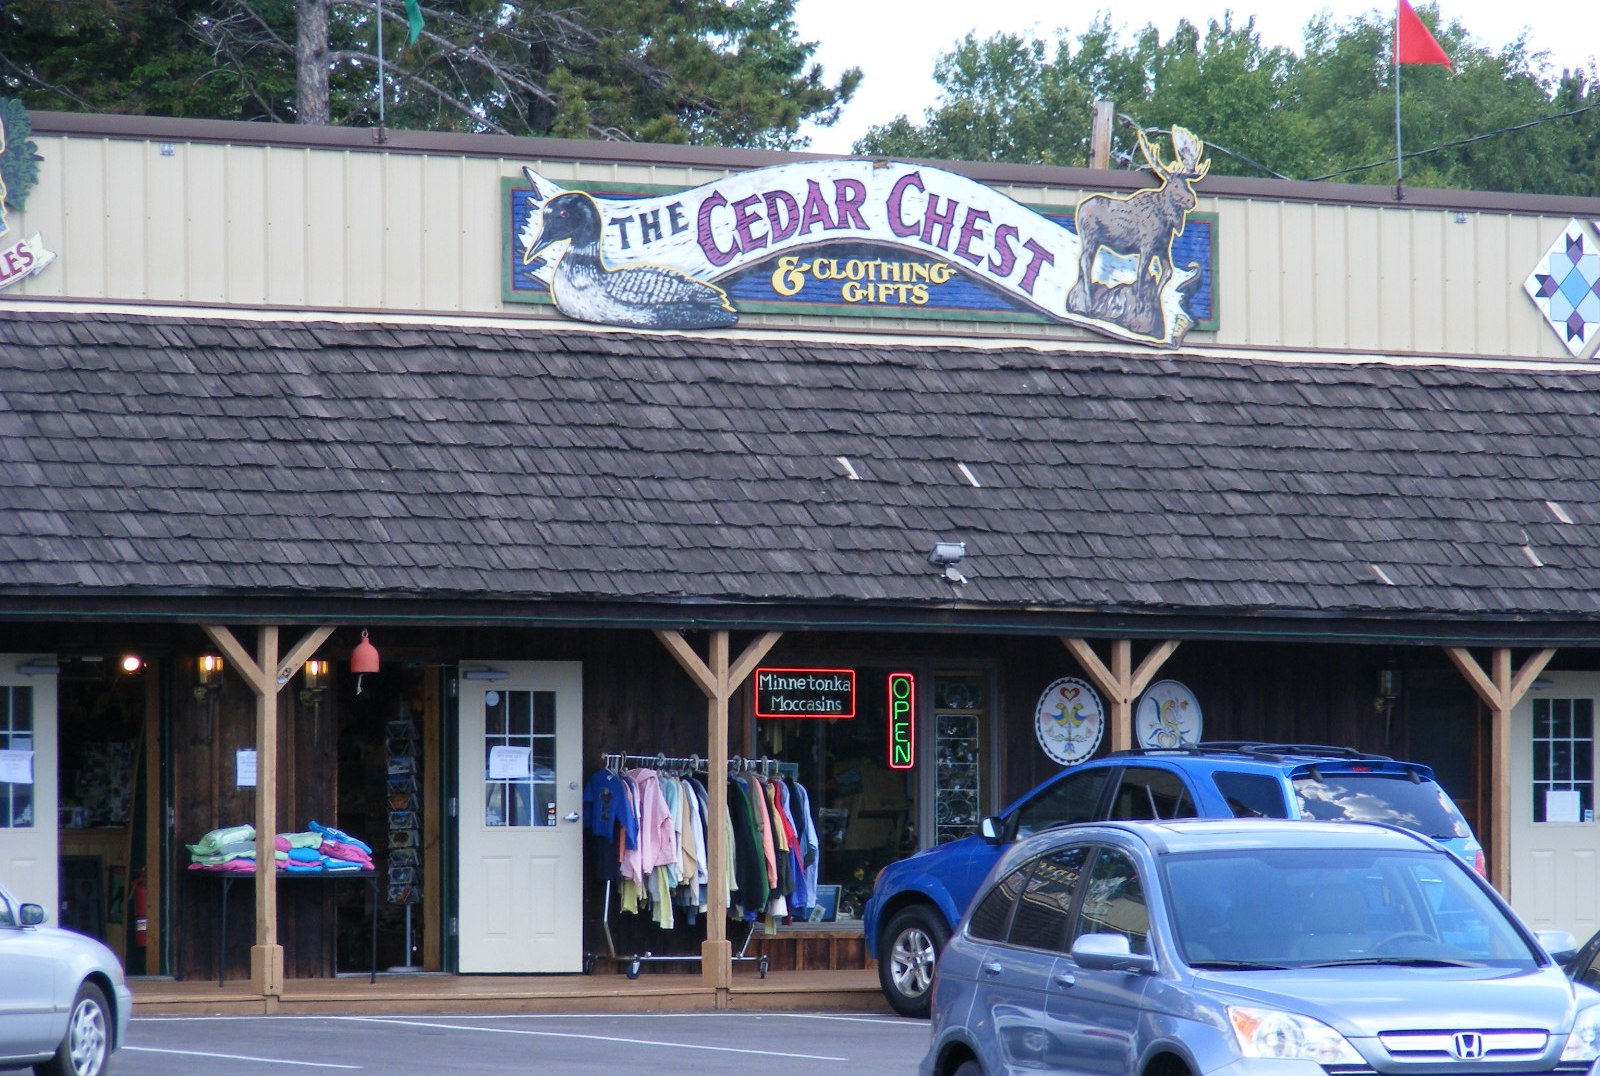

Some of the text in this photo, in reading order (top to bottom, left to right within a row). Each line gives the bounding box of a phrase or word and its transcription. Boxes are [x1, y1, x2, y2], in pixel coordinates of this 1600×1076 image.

[608, 170, 1055, 296] THE CEDAR CHEST
[772, 256, 958, 297] & CLOTHING
[842, 282, 931, 305] GIFTS
[759, 673, 851, 691] Minnetonka
[770, 696, 842, 712] Moccasins
[893, 678, 910, 763] OPEN
